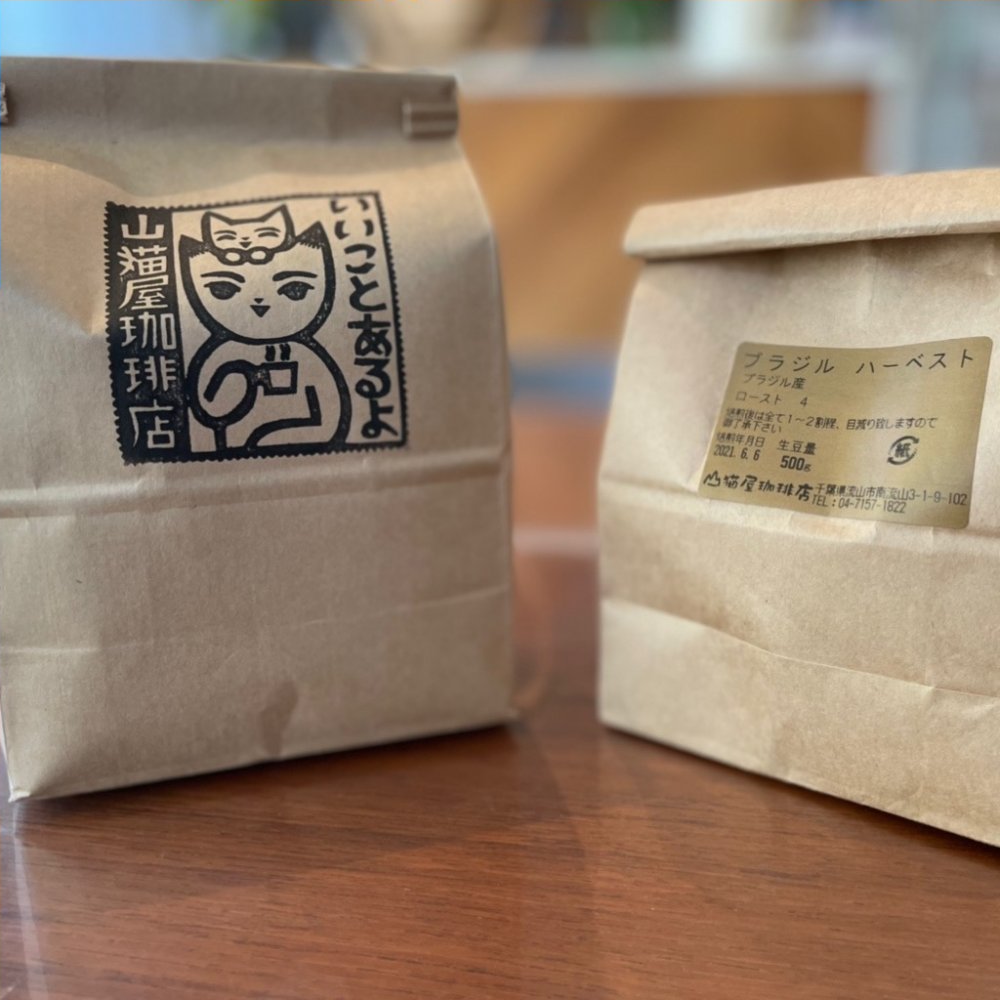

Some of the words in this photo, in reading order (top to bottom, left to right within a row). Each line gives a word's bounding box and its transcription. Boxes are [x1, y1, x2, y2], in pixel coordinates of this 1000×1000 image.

[118, 213, 178, 449] 山猫屋珈琲店
[329, 198, 399, 438] いいことあるよ
[743, 352, 835, 375] ブラジル
[856, 347, 975, 375] ハーベスト
[743, 373, 807, 390] ブラジル産
[735, 390, 783, 405] ロースト
[800, 396, 808, 408] 4
[778, 439, 817, 456] 生豆量
[703, 469, 814, 502] 山猫屋珈琲店
